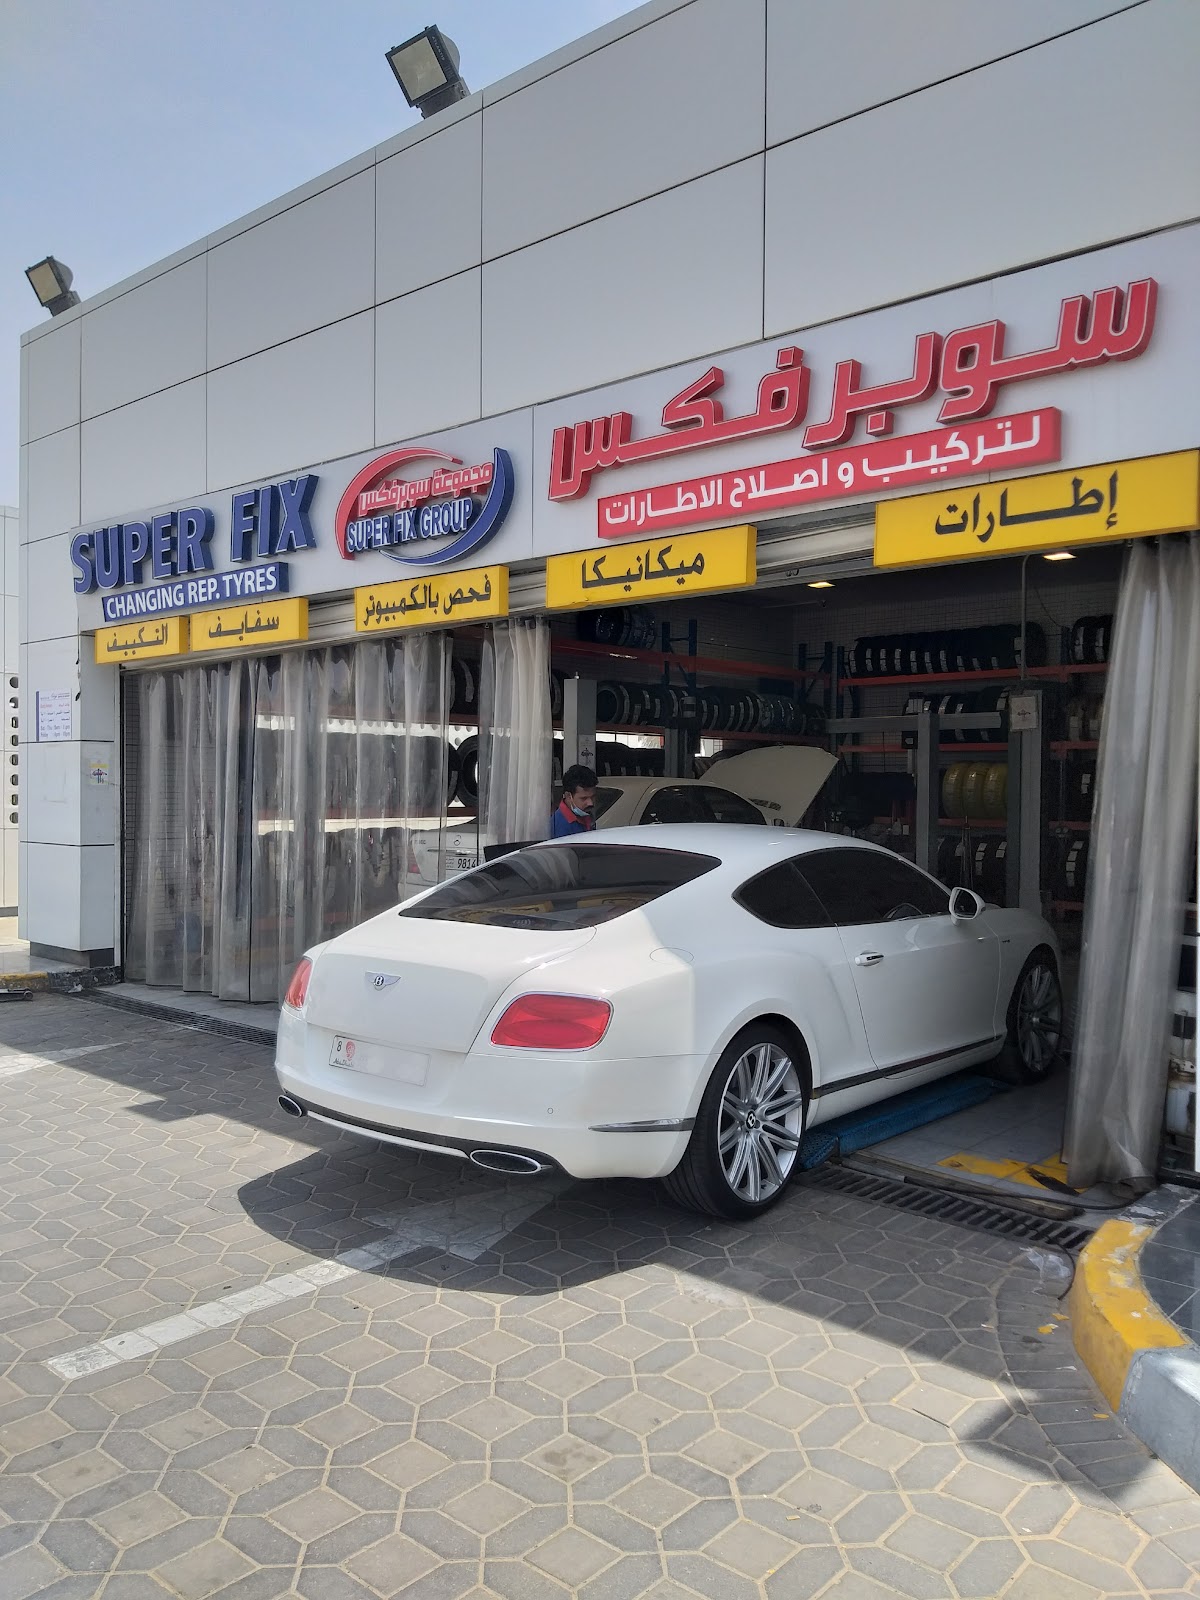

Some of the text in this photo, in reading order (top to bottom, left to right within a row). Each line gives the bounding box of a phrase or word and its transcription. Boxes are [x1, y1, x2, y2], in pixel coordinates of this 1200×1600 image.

[430, 461, 494, 499] مجموعة
[605, 414, 1041, 526] لتركيب و اصلاح الاطارات
[346, 497, 473, 553] SUPER FIX GROUP
[934, 469, 1119, 543] إطارات
[70, 473, 320, 595] SUPER FIX
[106, 566, 277, 619] CHANGING REP. TYRES
[580, 543, 706, 592] ميكانيكا
[363, 573, 492, 627] فحص بالكمبيوتر
[106, 621, 169, 657] التكييف
